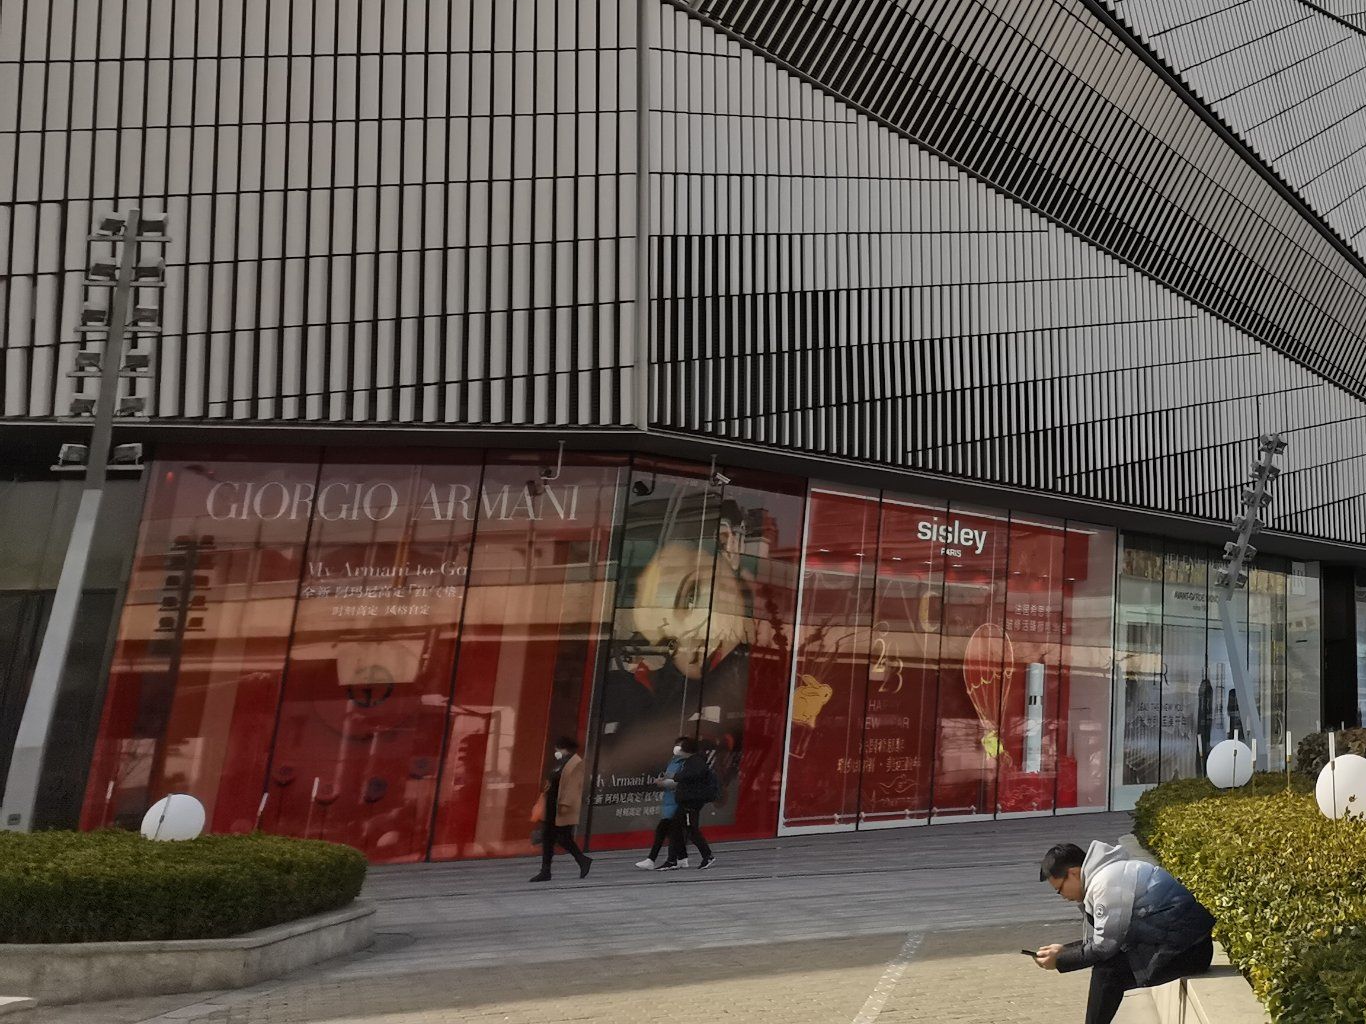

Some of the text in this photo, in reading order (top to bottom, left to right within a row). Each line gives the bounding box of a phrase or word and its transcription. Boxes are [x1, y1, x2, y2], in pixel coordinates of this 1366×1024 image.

[206, 481, 580, 522] GIORGIO ARMANI
[917, 517, 987, 554] sisley
[941, 547, 962, 558] PARIS
[345, 562, 409, 576] Armani
